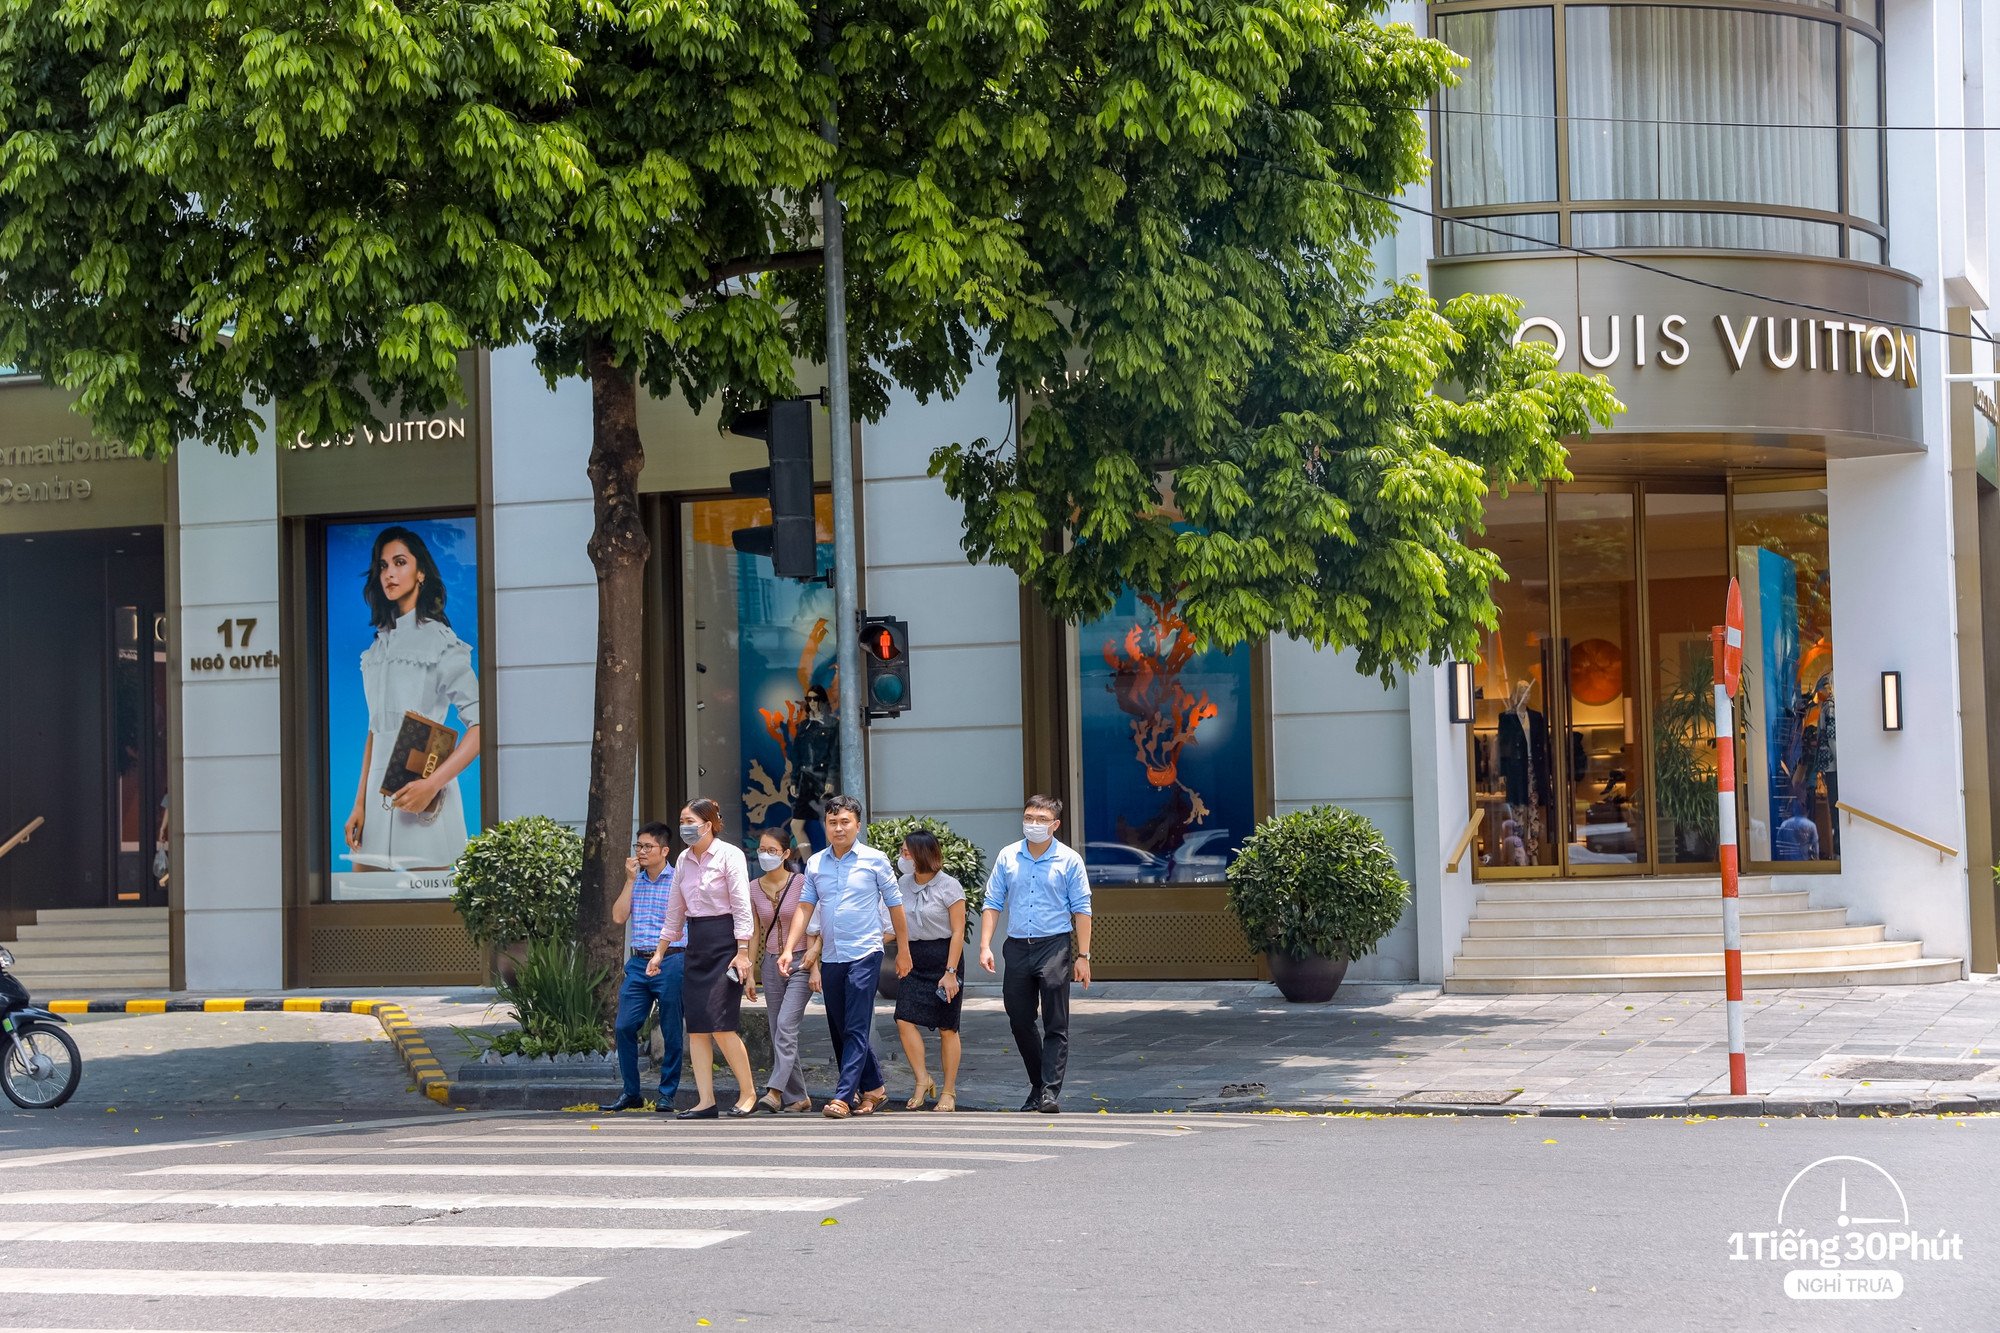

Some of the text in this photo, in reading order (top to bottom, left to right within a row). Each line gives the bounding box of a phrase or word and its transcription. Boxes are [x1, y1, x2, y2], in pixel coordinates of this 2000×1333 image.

[1511, 313, 1918, 389] OUIS VUITTON
[362, 417, 465, 445] VUITTON
[0, 436, 137, 465] rnationa
[217, 618, 257, 648] 17
[410, 879, 439, 889] LOUIS
